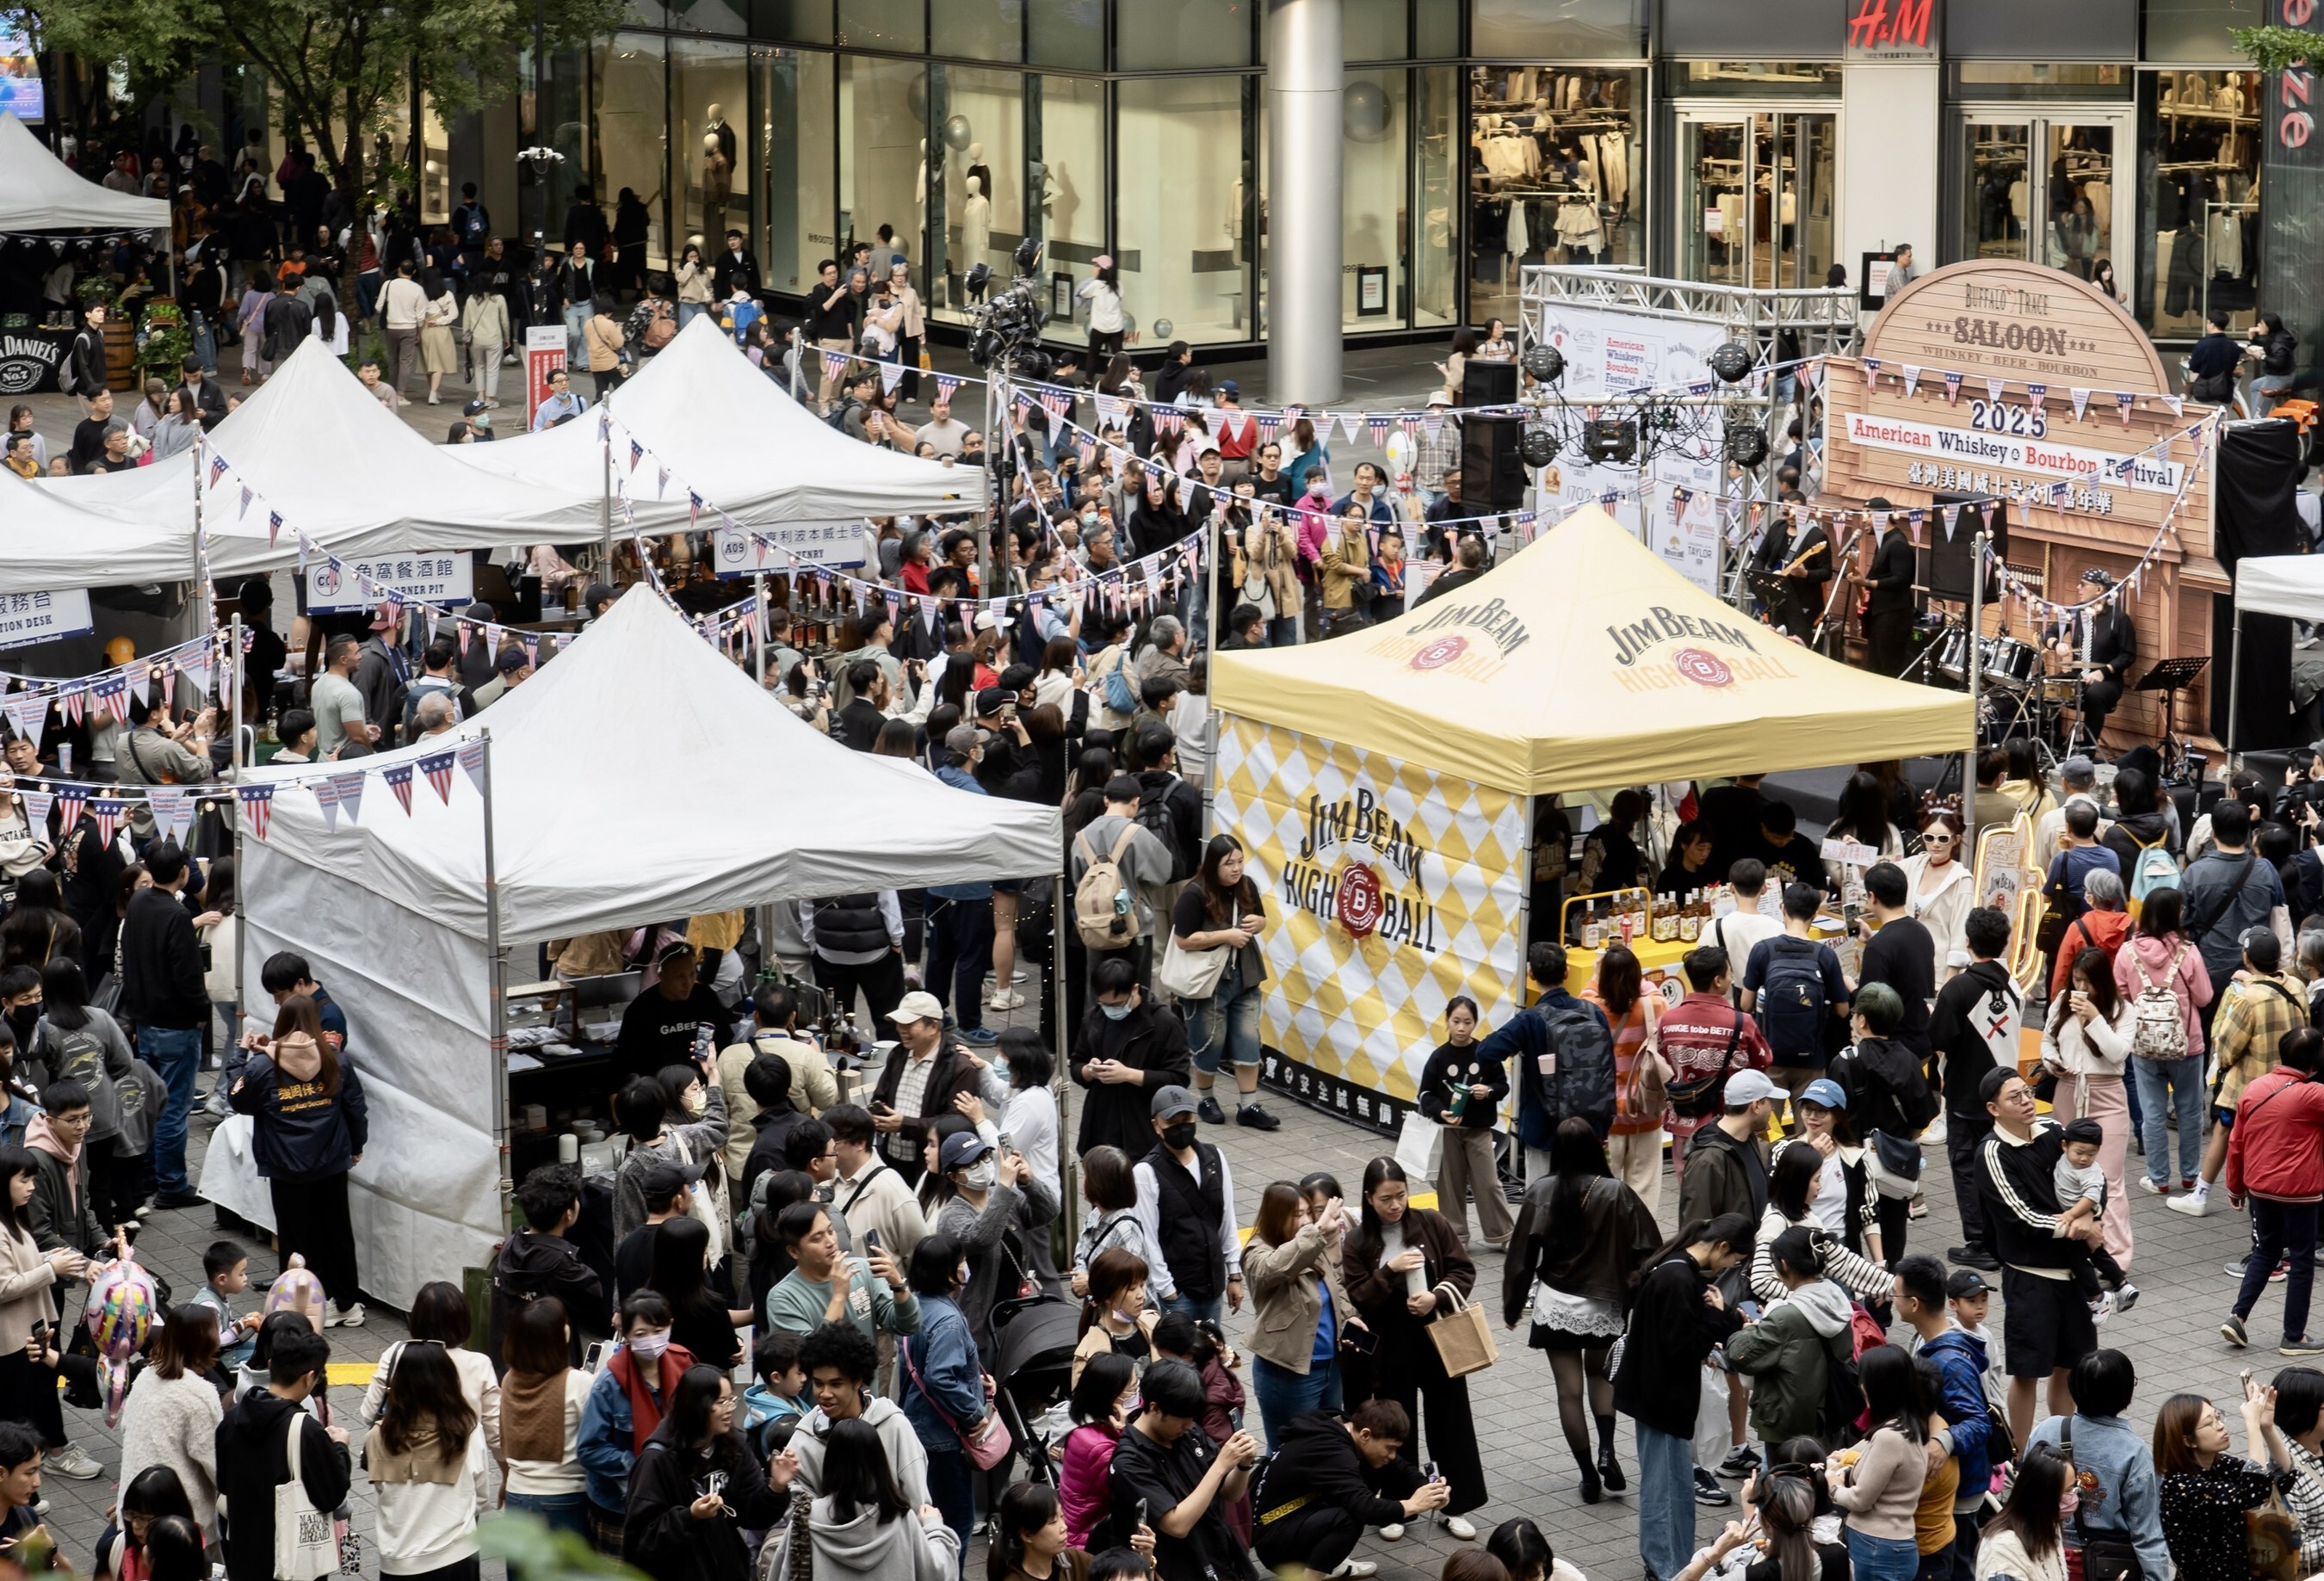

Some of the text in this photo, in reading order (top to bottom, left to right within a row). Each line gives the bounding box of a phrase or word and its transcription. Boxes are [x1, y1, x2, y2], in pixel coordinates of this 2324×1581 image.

[1848, 0, 1933, 47] H&M
[2280, 0, 2319, 148] eze
[1965, 283, 2049, 316] BUFFALO TRACE
[4, 336, 59, 363] DANIEL'S
[1606, 337, 1645, 351] American
[1954, 315, 2067, 356] SALOON
[1605, 361, 1640, 374] Bourbon
[1922, 345, 1983, 362] WHISKEY
[1993, 355, 2027, 369] BEER
[2037, 361, 2098, 378] BOURBON
[1604, 373, 1635, 386] Festival
[1972, 402, 2048, 439] 2025
[1854, 418, 1932, 448] American
[1938, 431, 2008, 464] Whiskey
[2025, 446, 2097, 472] Bourbon
[2105, 458, 2174, 487] Fetival
[1907, 461, 2113, 515] 臺灣美國威士忌文化嘉年華
[725, 542, 745, 553] A09
[1688, 546, 1712, 559] TAYLOR
[389, 585, 426, 596] ORNER
[430, 584, 443, 594] PIT
[26, 614, 53, 629] DESK
[1406, 597, 1530, 660] JIM BEAM
[1606, 606, 1762, 667] JIM BEAM
[1444, 652, 1507, 684] BALL
[1611, 656, 1800, 694] HIGH BALL
[1301, 787, 1425, 900] JIM BEAM
[1283, 861, 1436, 953] HIGH BALL
[1352, 887, 1367, 911] B
